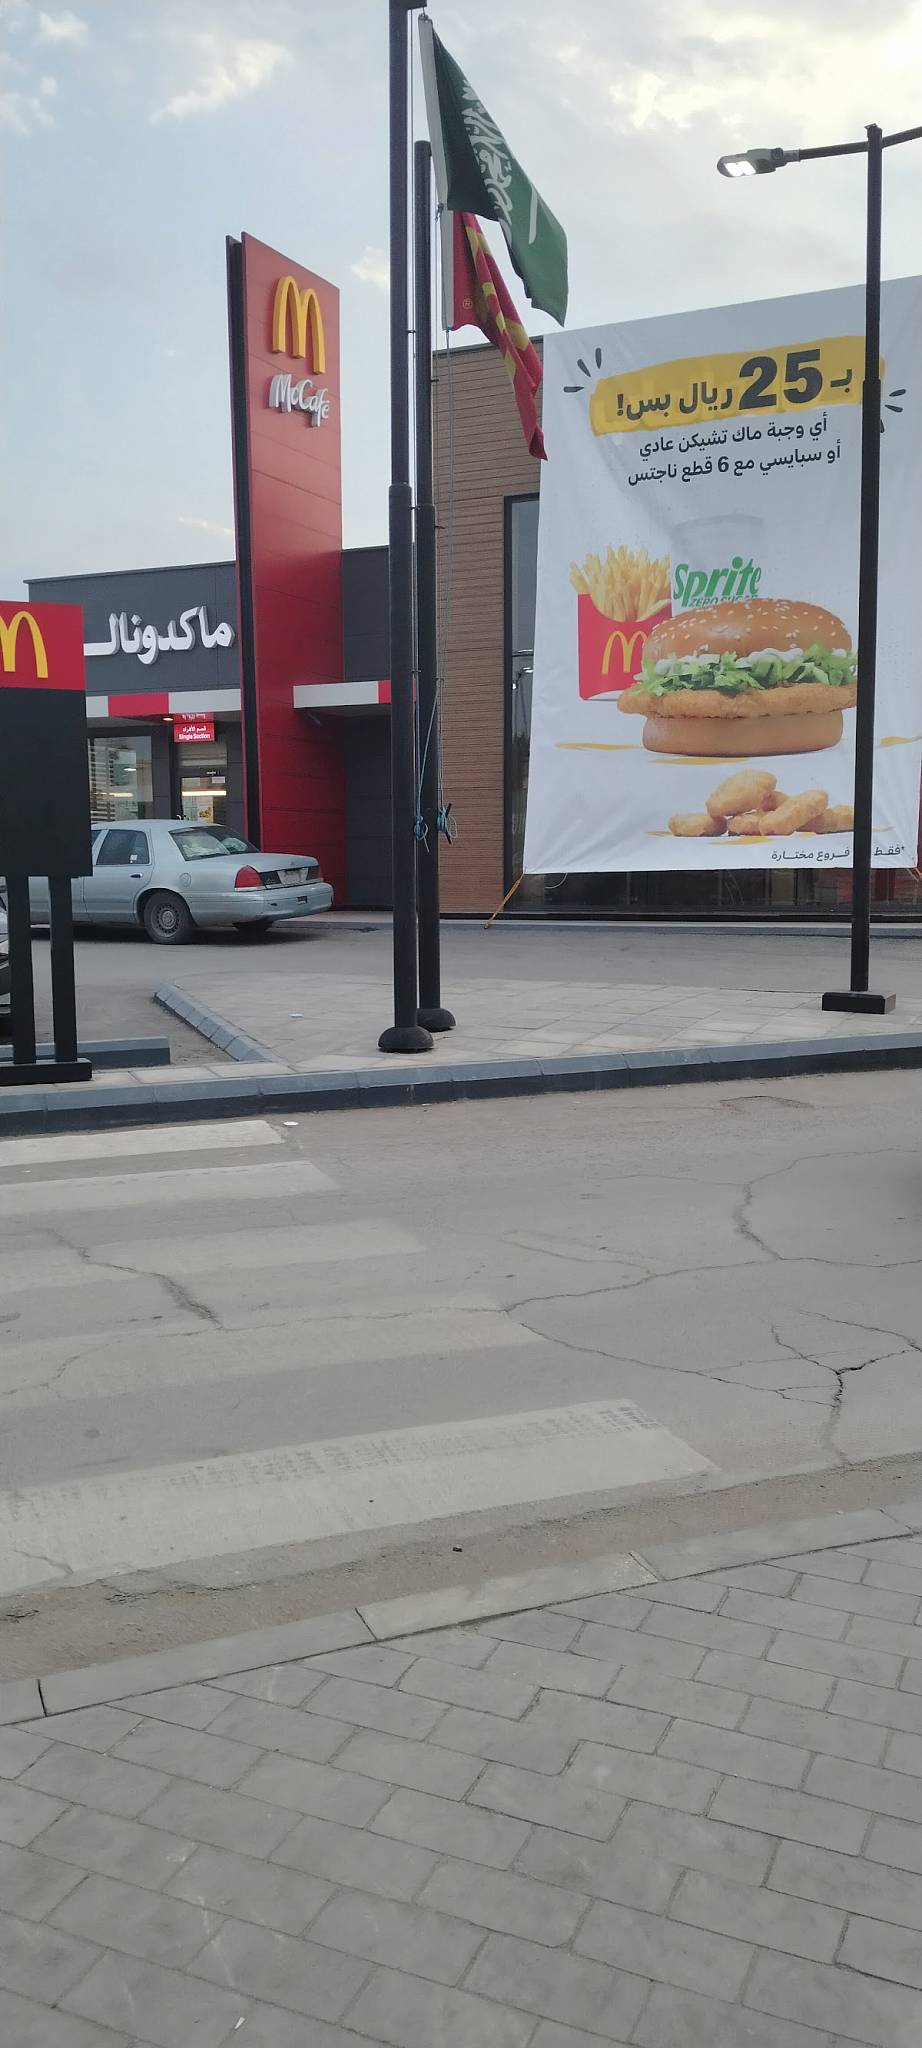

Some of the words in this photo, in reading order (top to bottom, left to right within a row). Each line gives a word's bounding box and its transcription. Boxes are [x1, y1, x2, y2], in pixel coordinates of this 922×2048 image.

[739, 348, 823, 410] 25
[616, 393, 671, 421] بس!
[679, 381, 733, 414] ريال
[732, 426, 762, 442] ماك
[767, 421, 804, 441] وجبة
[809, 411, 828, 441] أي
[639, 436, 674, 462] عادي
[678, 430, 728, 453] تشيكن
[827, 438, 841, 464] أو
[628, 463, 678, 486] ناجتس
[681, 456, 713, 482] قطع
[717, 456, 730, 473] 6
[733, 459, 755, 476] مع
[759, 448, 822, 476] سبايسي
[672, 556, 761, 607] Sprite
[83, 605, 235, 665] ماكدونال
